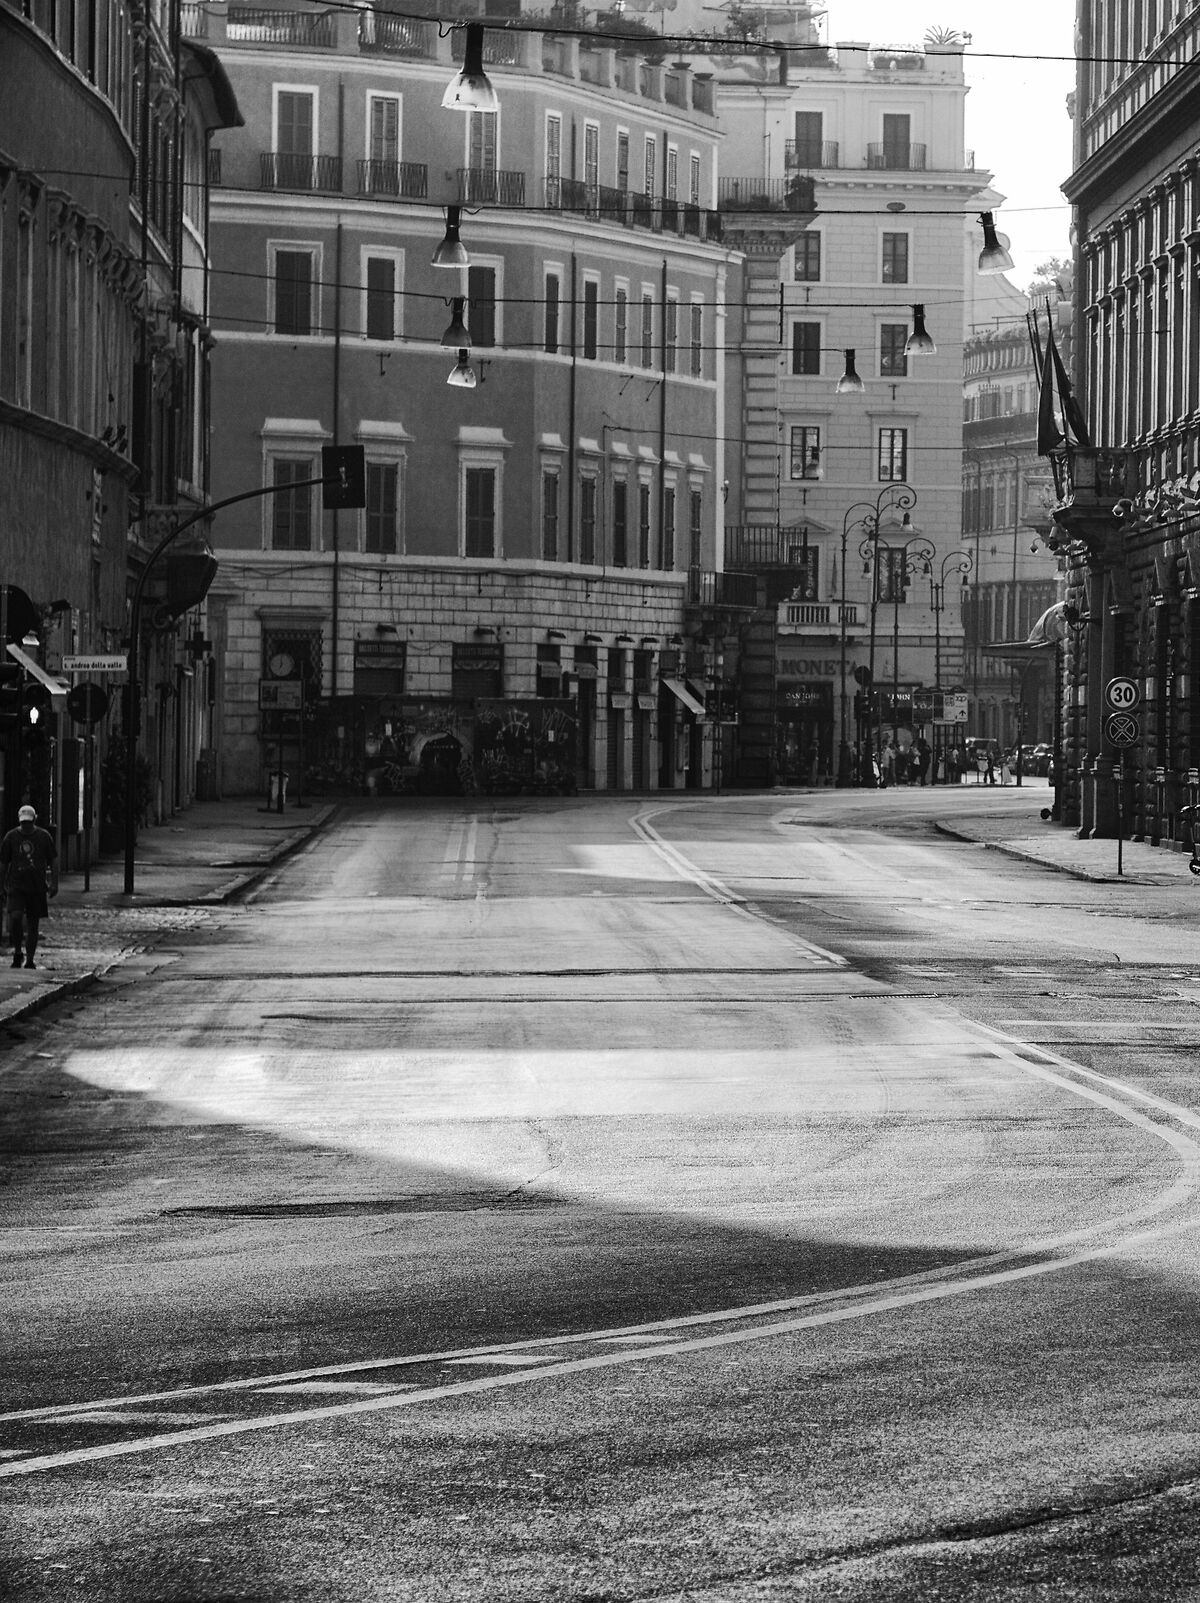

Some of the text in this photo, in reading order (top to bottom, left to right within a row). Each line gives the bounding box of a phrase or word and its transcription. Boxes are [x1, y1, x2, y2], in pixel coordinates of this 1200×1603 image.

[71, 661, 90, 669] andrea
[91, 661, 106, 669] della
[107, 661, 122, 669] valle
[1113, 686, 1133, 703] 30
